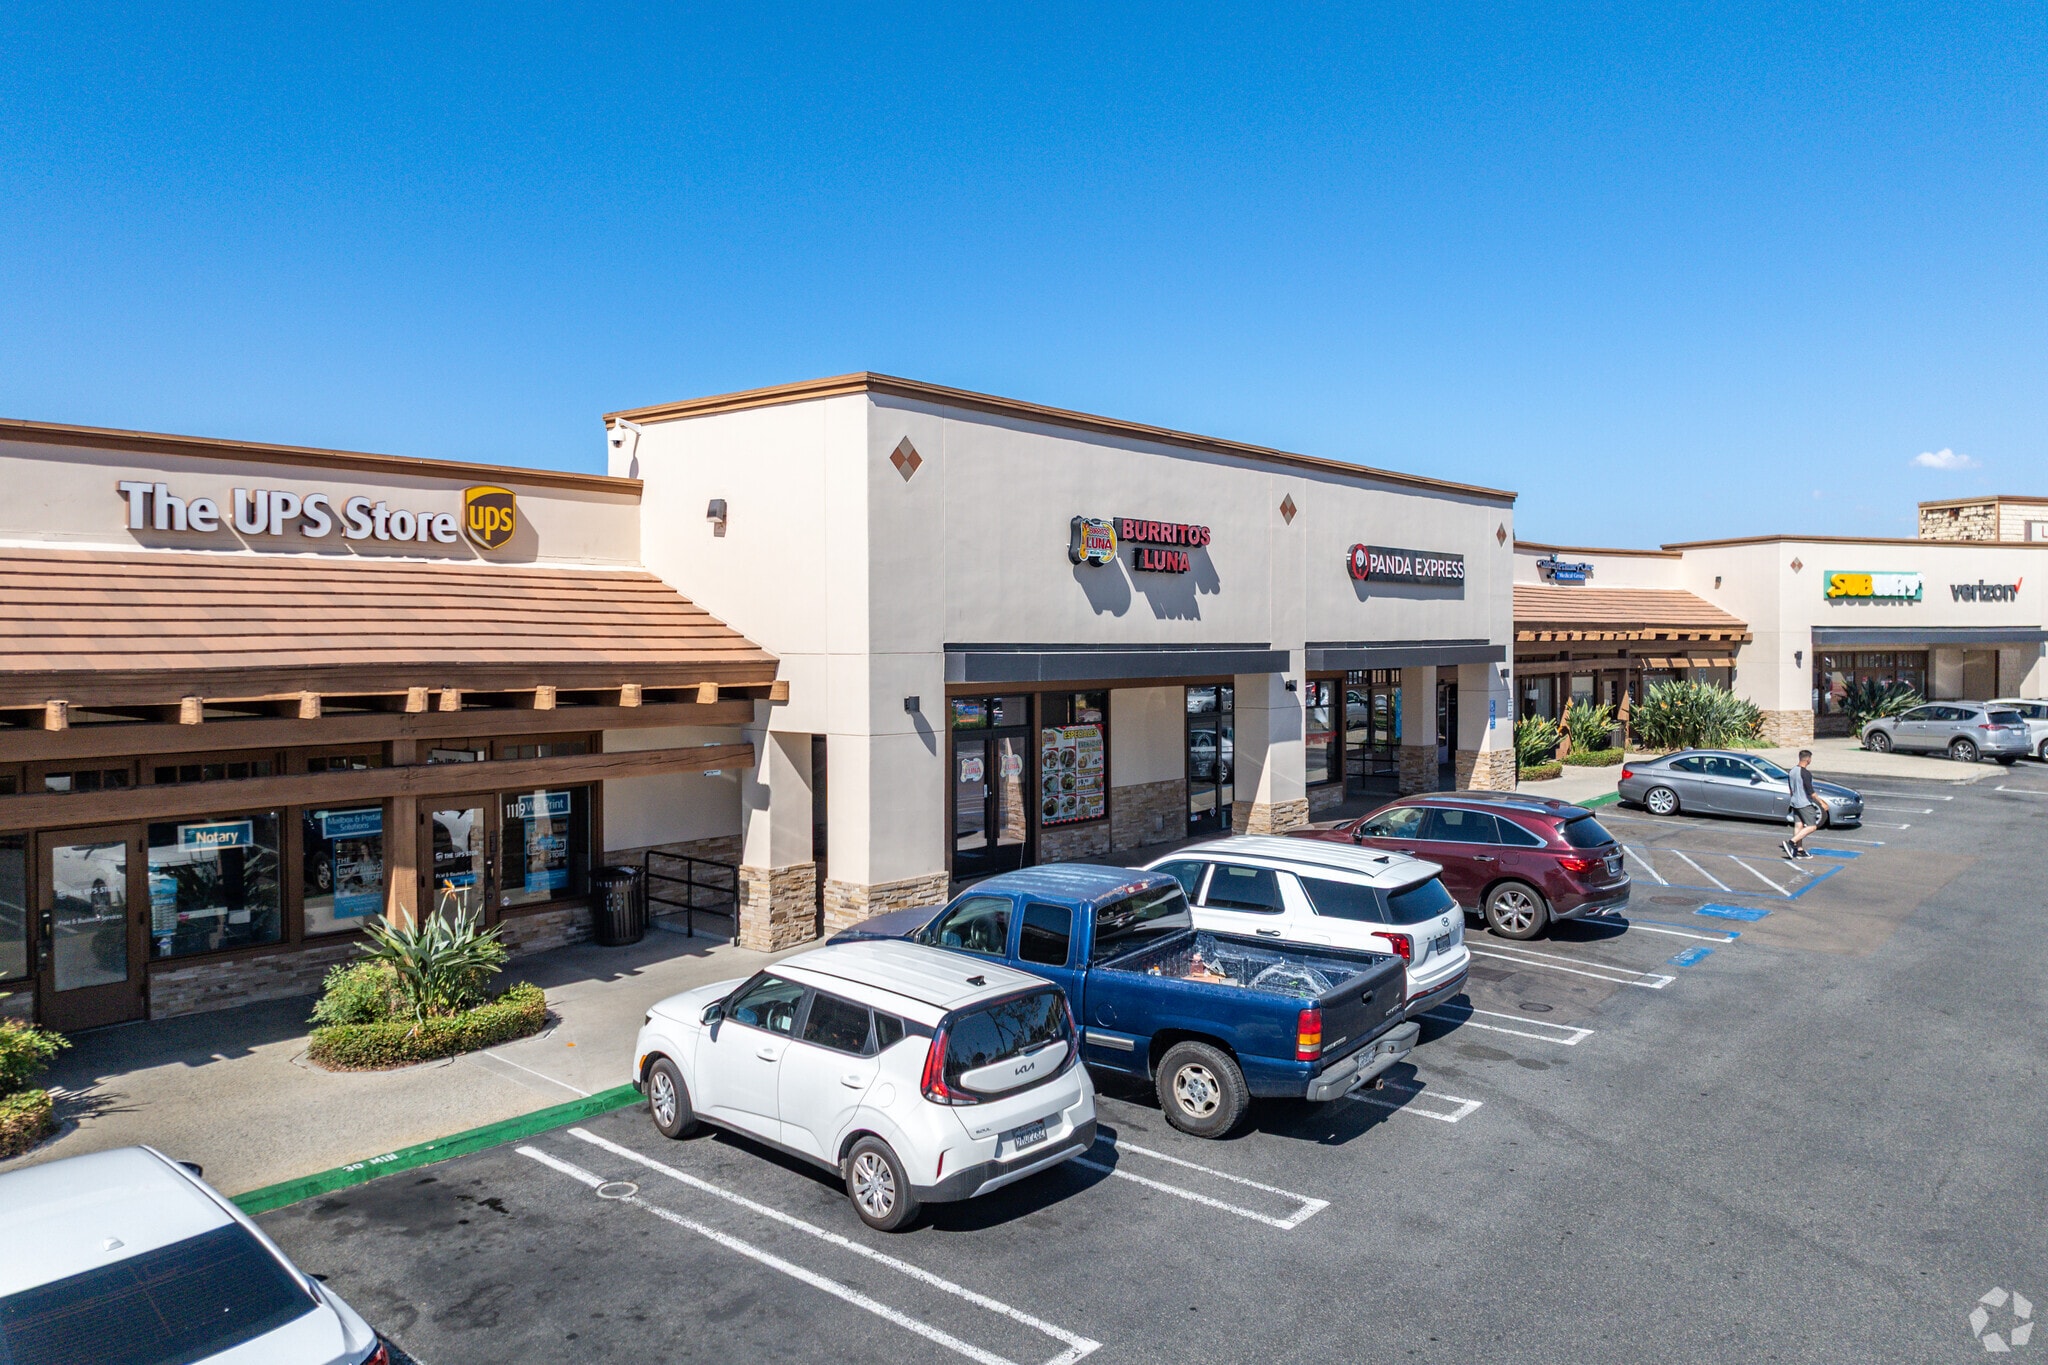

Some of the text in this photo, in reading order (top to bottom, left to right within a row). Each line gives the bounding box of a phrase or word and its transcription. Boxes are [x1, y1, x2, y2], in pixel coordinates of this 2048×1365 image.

[118, 480, 458, 544] The UPS Store
[469, 505, 513, 541] ups
[1086, 536, 1113, 550] LUNA
[1122, 518, 1211, 546] BURRITOS
[1143, 548, 1191, 572] LUNA
[1369, 553, 1464, 579] PANDA EXPRESS
[1827, 572, 1927, 599] SUBWAY
[1950, 579, 2016, 603] verizon
[506, 803, 526, 819] 1119
[525, 798, 564, 812] We Print
[195, 831, 239, 845] Notary
[342, 1152, 399, 1172] 30 MIN
